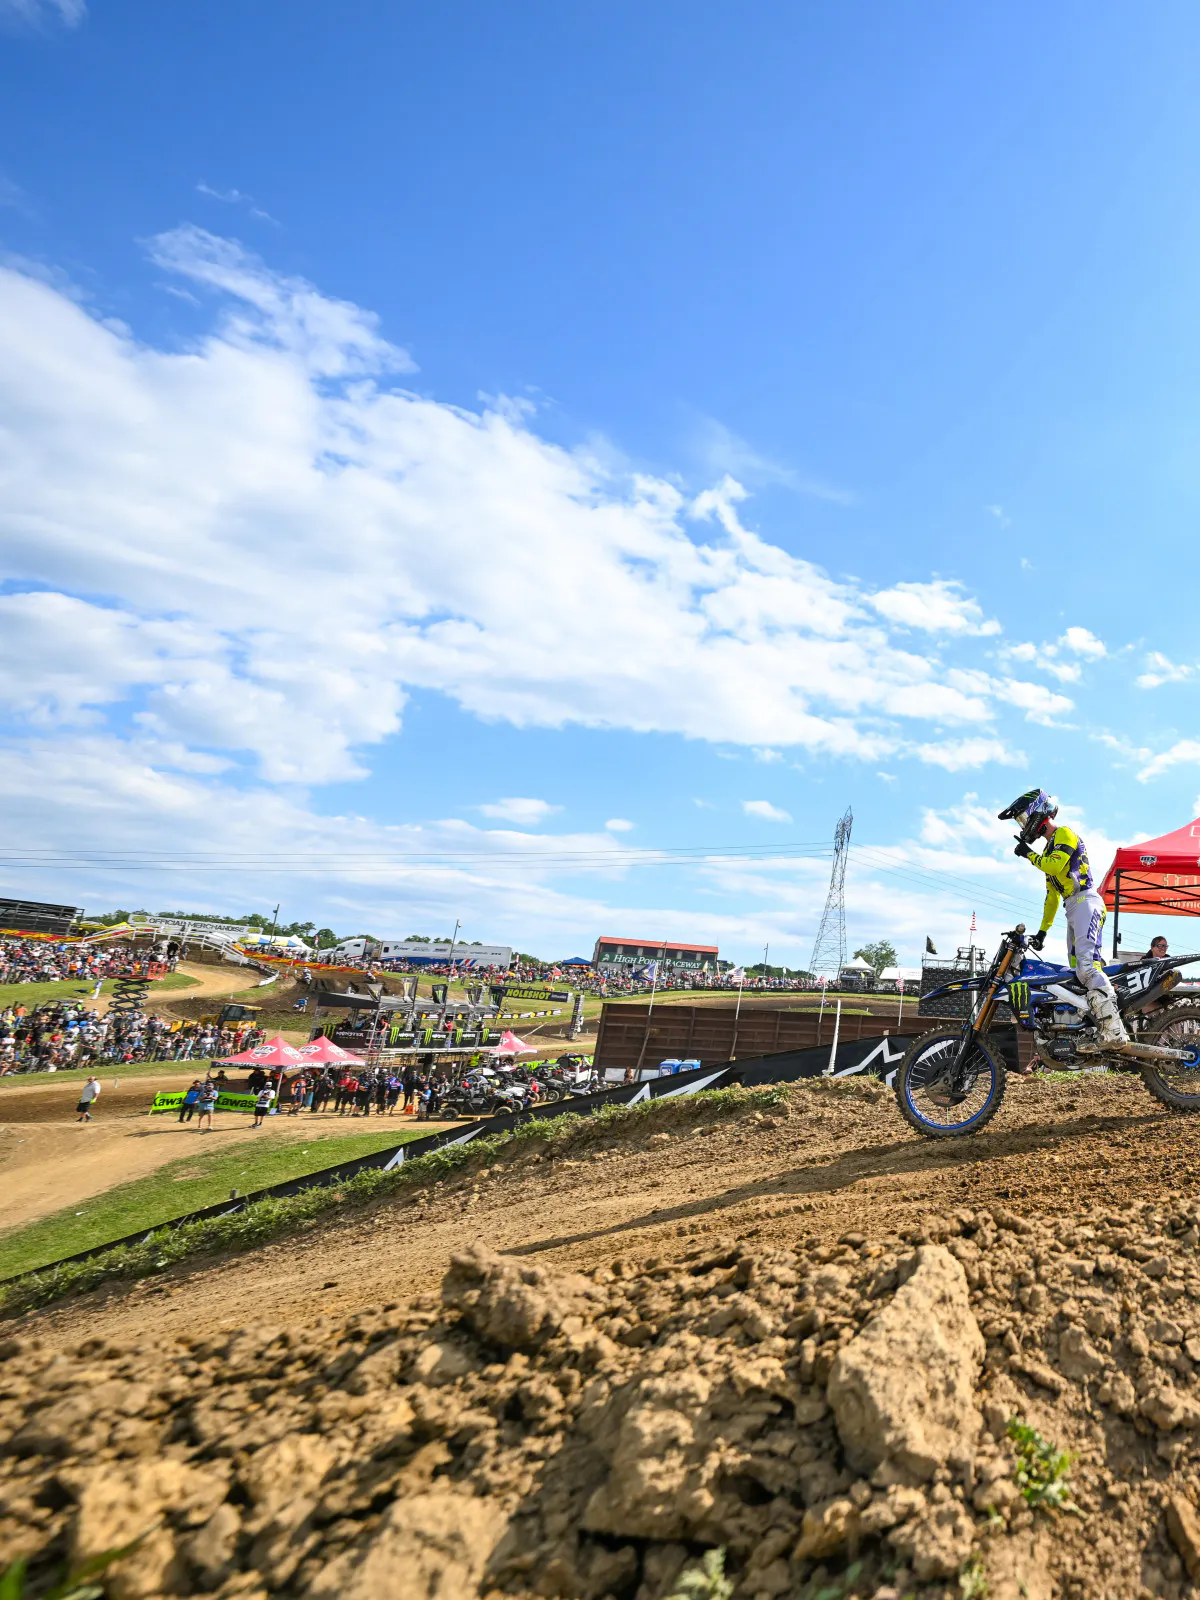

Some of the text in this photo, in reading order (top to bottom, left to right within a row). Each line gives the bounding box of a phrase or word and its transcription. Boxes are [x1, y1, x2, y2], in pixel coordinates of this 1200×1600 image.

[187, 921, 245, 933] MERCHANDISE
[1086, 908, 1101, 942] THOR
[613, 954, 637, 965] HIGH
[665, 958, 702, 970] RACEWAY
[1126, 966, 1153, 994] 37
[507, 988, 551, 1000] HOLESHOT
